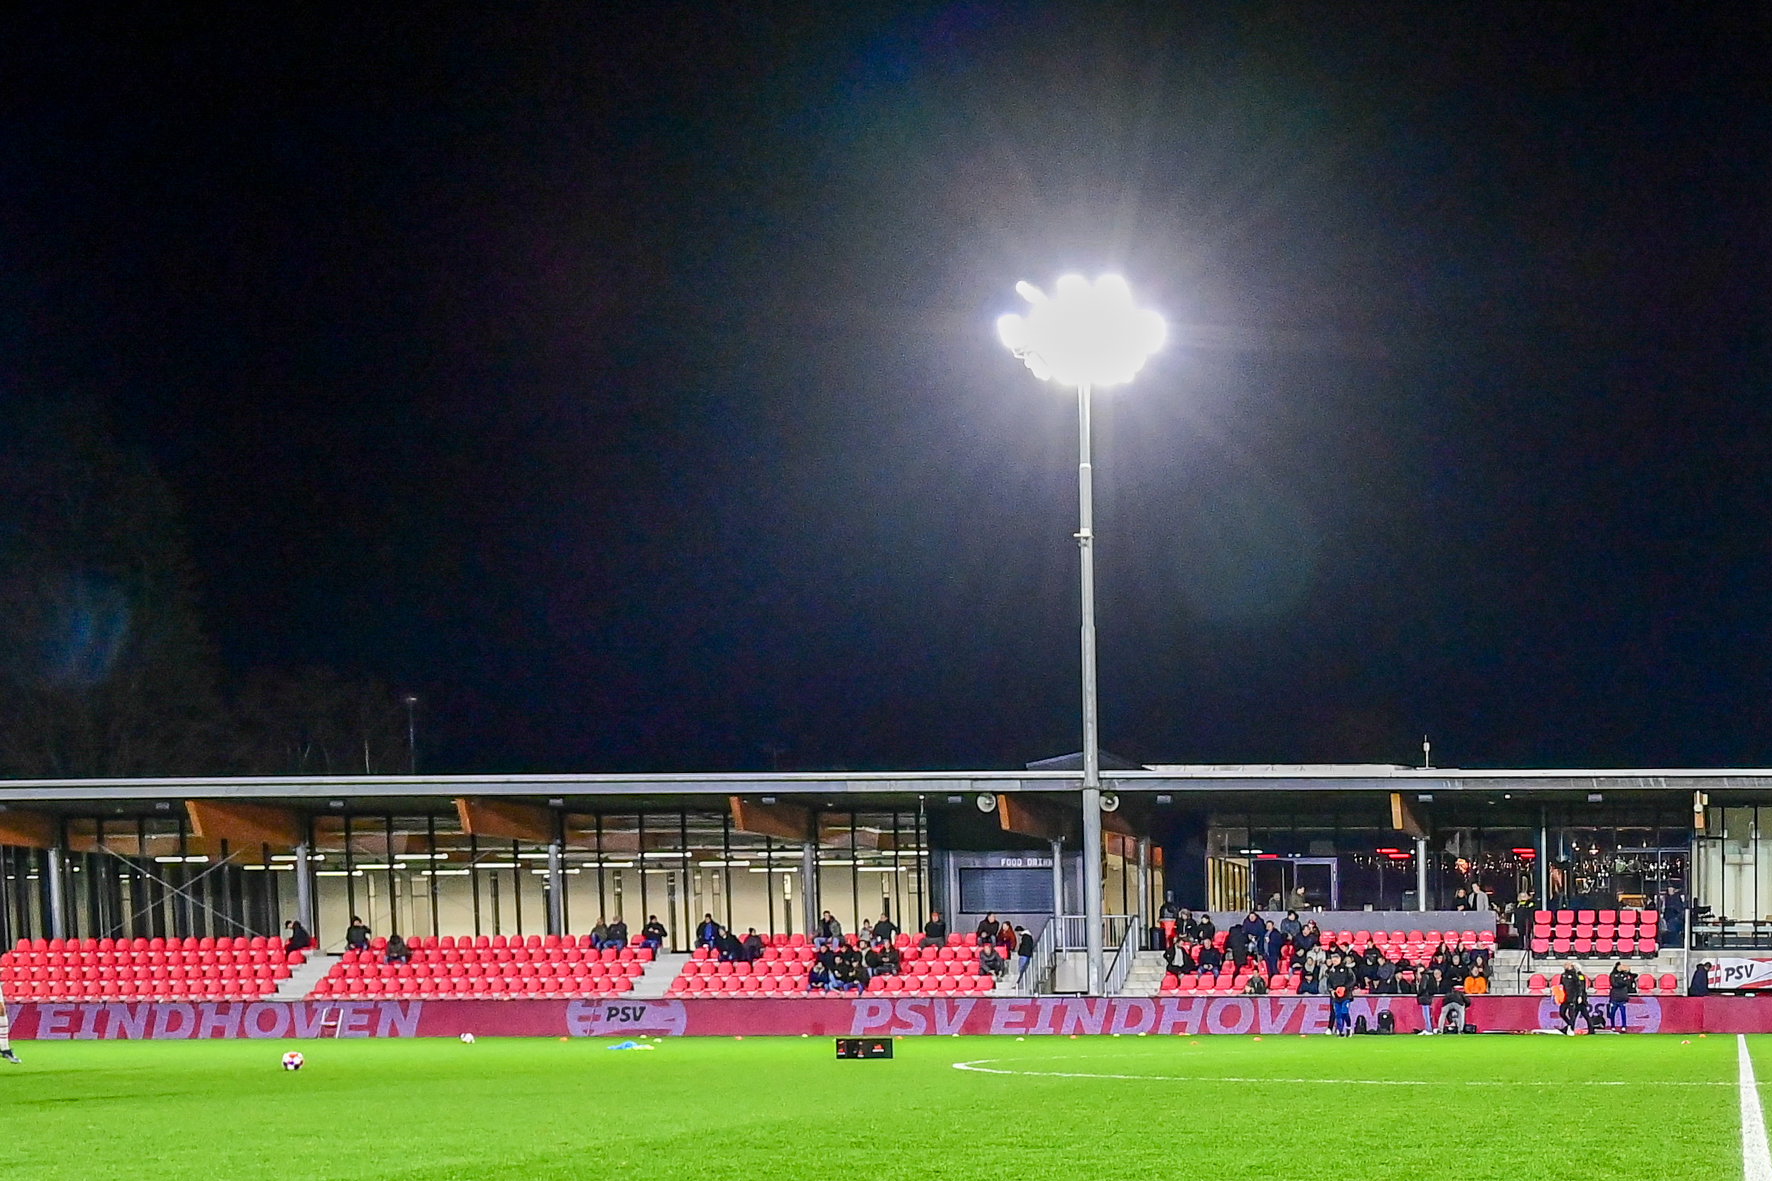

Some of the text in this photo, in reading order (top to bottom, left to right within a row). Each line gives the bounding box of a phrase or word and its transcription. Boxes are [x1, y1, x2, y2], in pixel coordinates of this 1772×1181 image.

[1001, 858, 1053, 866] FOOD DRINK
[1725, 964, 1755, 982] PSV
[35, 1002, 422, 1039] EINDHOVEN
[606, 1006, 646, 1022] PSV
[850, 998, 977, 1035] PSV
